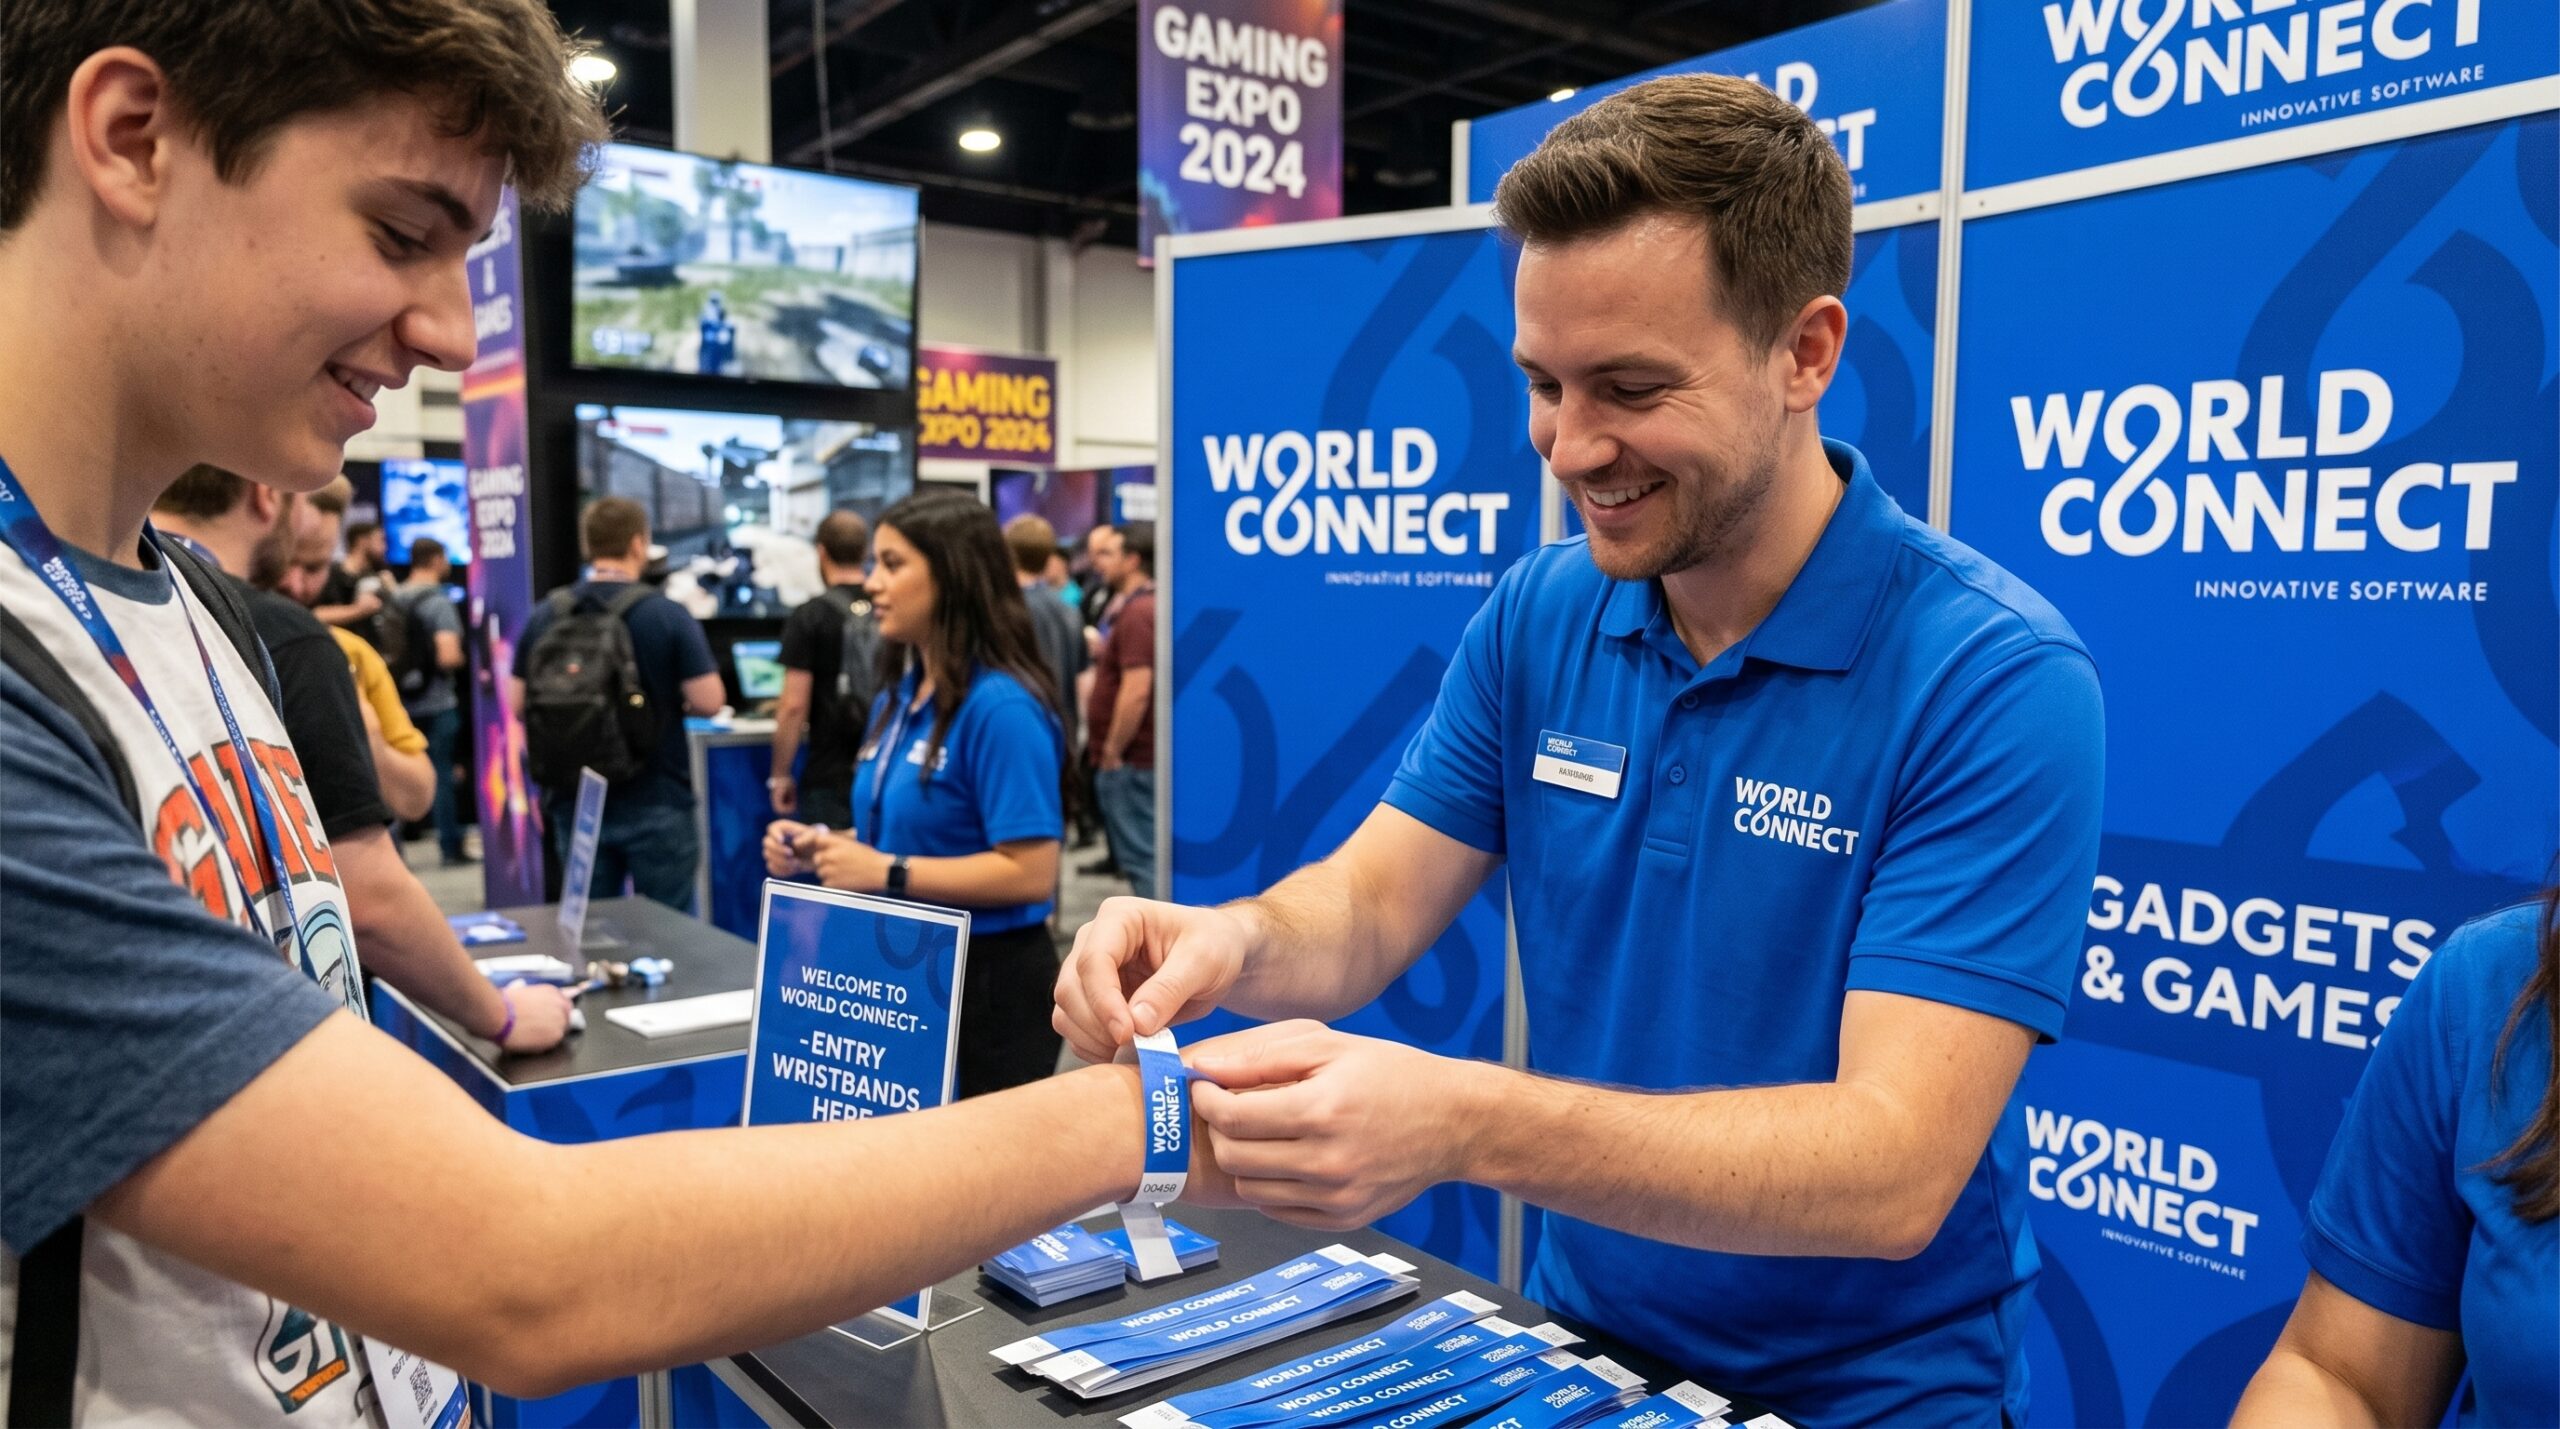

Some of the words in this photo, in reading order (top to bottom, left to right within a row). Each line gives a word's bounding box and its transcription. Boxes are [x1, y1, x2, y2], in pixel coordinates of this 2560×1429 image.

[1154, 5, 1328, 88] GAMING
[1185, 66, 1301, 135] EXPO
[2241, 88, 2361, 127] INNOVATIVE
[2371, 63, 2485, 102] SOFTWARE
[1178, 122, 1307, 199] 2024
[984, 416, 1053, 452] 2024
[2010, 369, 2395, 471] WORLD
[1202, 427, 1438, 492] WORLD
[1224, 491, 1510, 556] CONNECT
[2040, 460, 2518, 557] CONNECT
[1325, 571, 1410, 587] INNOVATIVE
[1415, 571, 1493, 588] SOFTWARE
[2195, 580, 2339, 599] INNOVATIVE
[2349, 580, 2488, 601] SOFTWARE
[1735, 777, 1832, 820] WORLD
[1734, 808, 1859, 855] CONNECT
[2087, 875, 2437, 980] GADGETS
[802, 965, 882, 999] WELCOME
[886, 984, 907, 1004] TO
[2081, 944, 2124, 1003] &
[781, 986, 836, 1014] WORLD
[839, 1000, 919, 1033] CONNECT
[772, 1052, 920, 1112] WRISTBANDS
[1152, 1090, 1167, 1154] WORLD
[1164, 1075, 1181, 1152] CONNECT
[2025, 1105, 2218, 1192] WORLD
[2029, 1156, 2259, 1257] CONNECT
[2101, 1227, 2174, 1258] INNOVATIVE
[2177, 1250, 2246, 1280] SOFTWARE
[1120, 1307, 1183, 1328] WORLD
[1184, 1283, 1256, 1311] CONNECT
[1168, 1319, 1230, 1342] WORLD
[1231, 1295, 1302, 1324] CONNECT
[1251, 1365, 1313, 1388] WORLD
[1313, 1338, 1387, 1368] CONNECT
[1277, 1386, 1341, 1411] WORLD
[1341, 1359, 1414, 1389] CONNECT
[1308, 1395, 1374, 1418] WORLD
[1375, 1369, 1455, 1399] CONNECT
[1390, 1394, 1468, 1429] CONNECT
